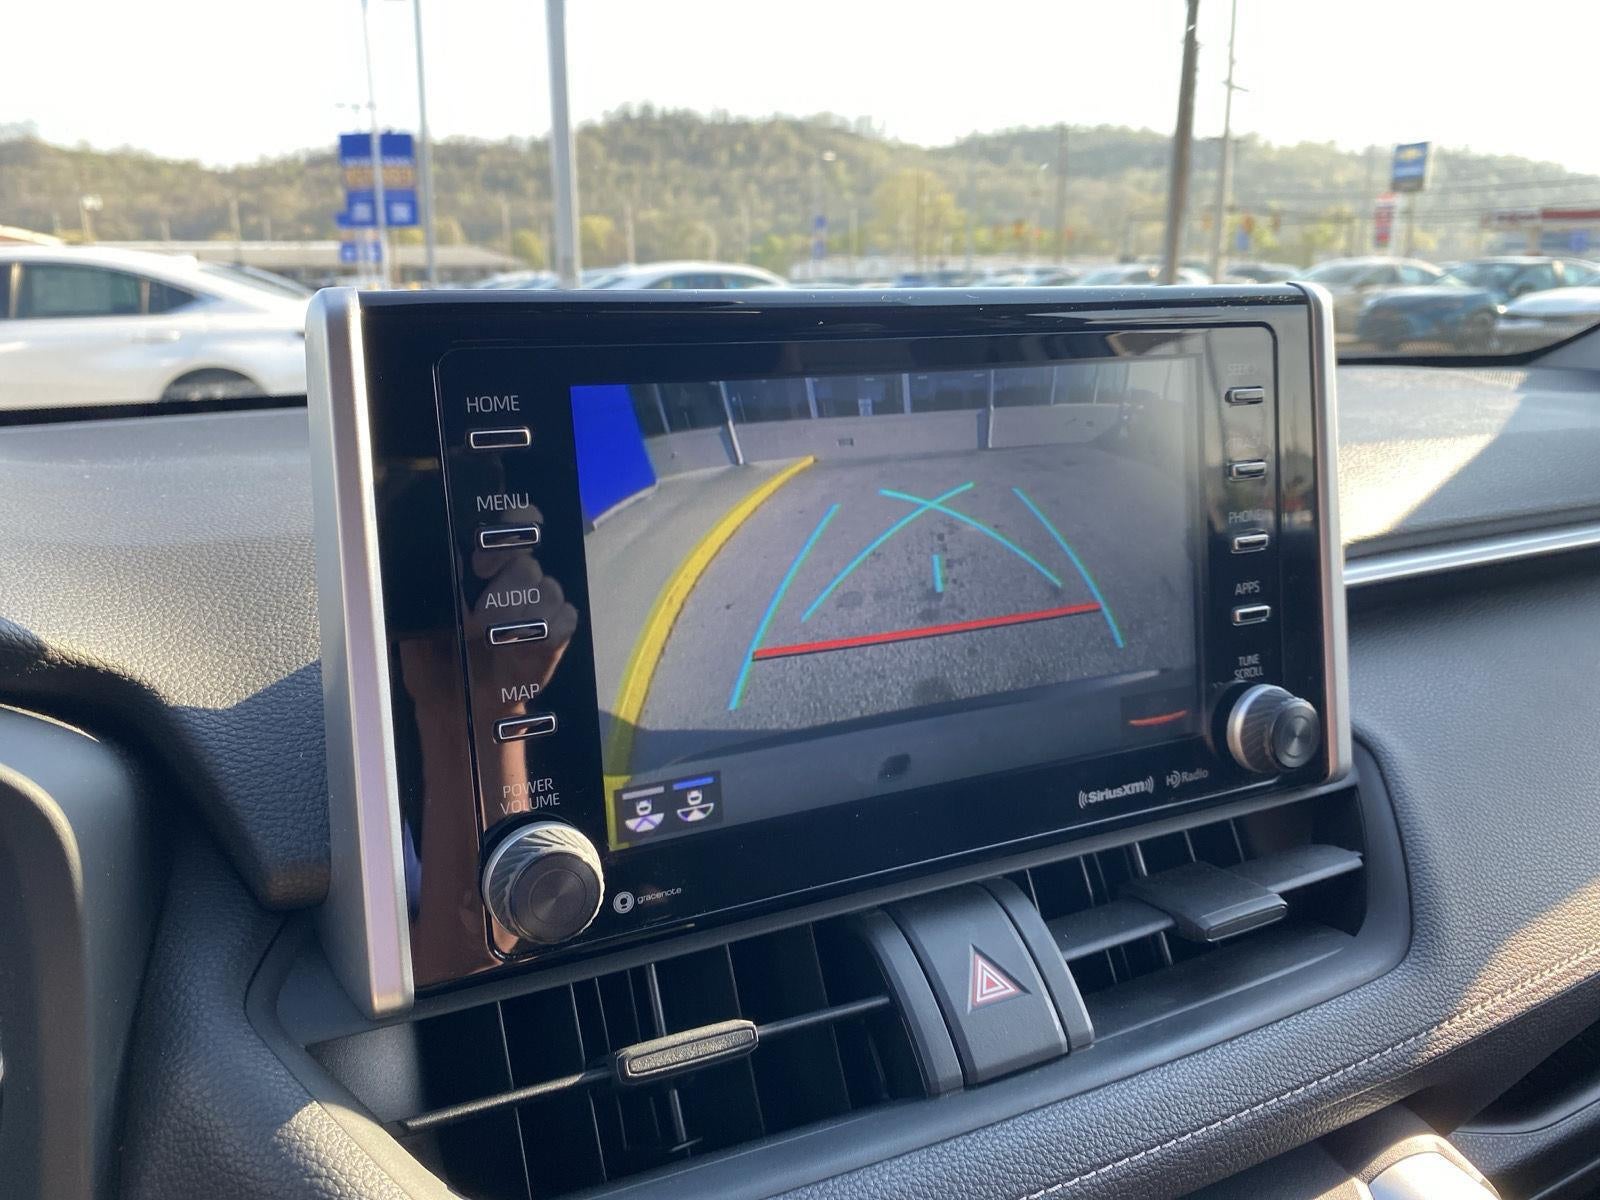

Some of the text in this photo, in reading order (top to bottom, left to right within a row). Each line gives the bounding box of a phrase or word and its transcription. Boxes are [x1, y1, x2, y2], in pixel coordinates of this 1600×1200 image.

[466, 395, 520, 413] HOME
[476, 493, 529, 512] MENU
[1235, 580, 1261, 595] APPS
[485, 588, 540, 609] AUDIO
[1238, 653, 1260, 667] TUNE
[1234, 666, 1264, 681] SCROLL
[501, 683, 540, 703] MAP
[502, 778, 554, 798] POWER
[500, 793, 561, 815] VOLUME
[637, 888, 682, 905] gracenote
